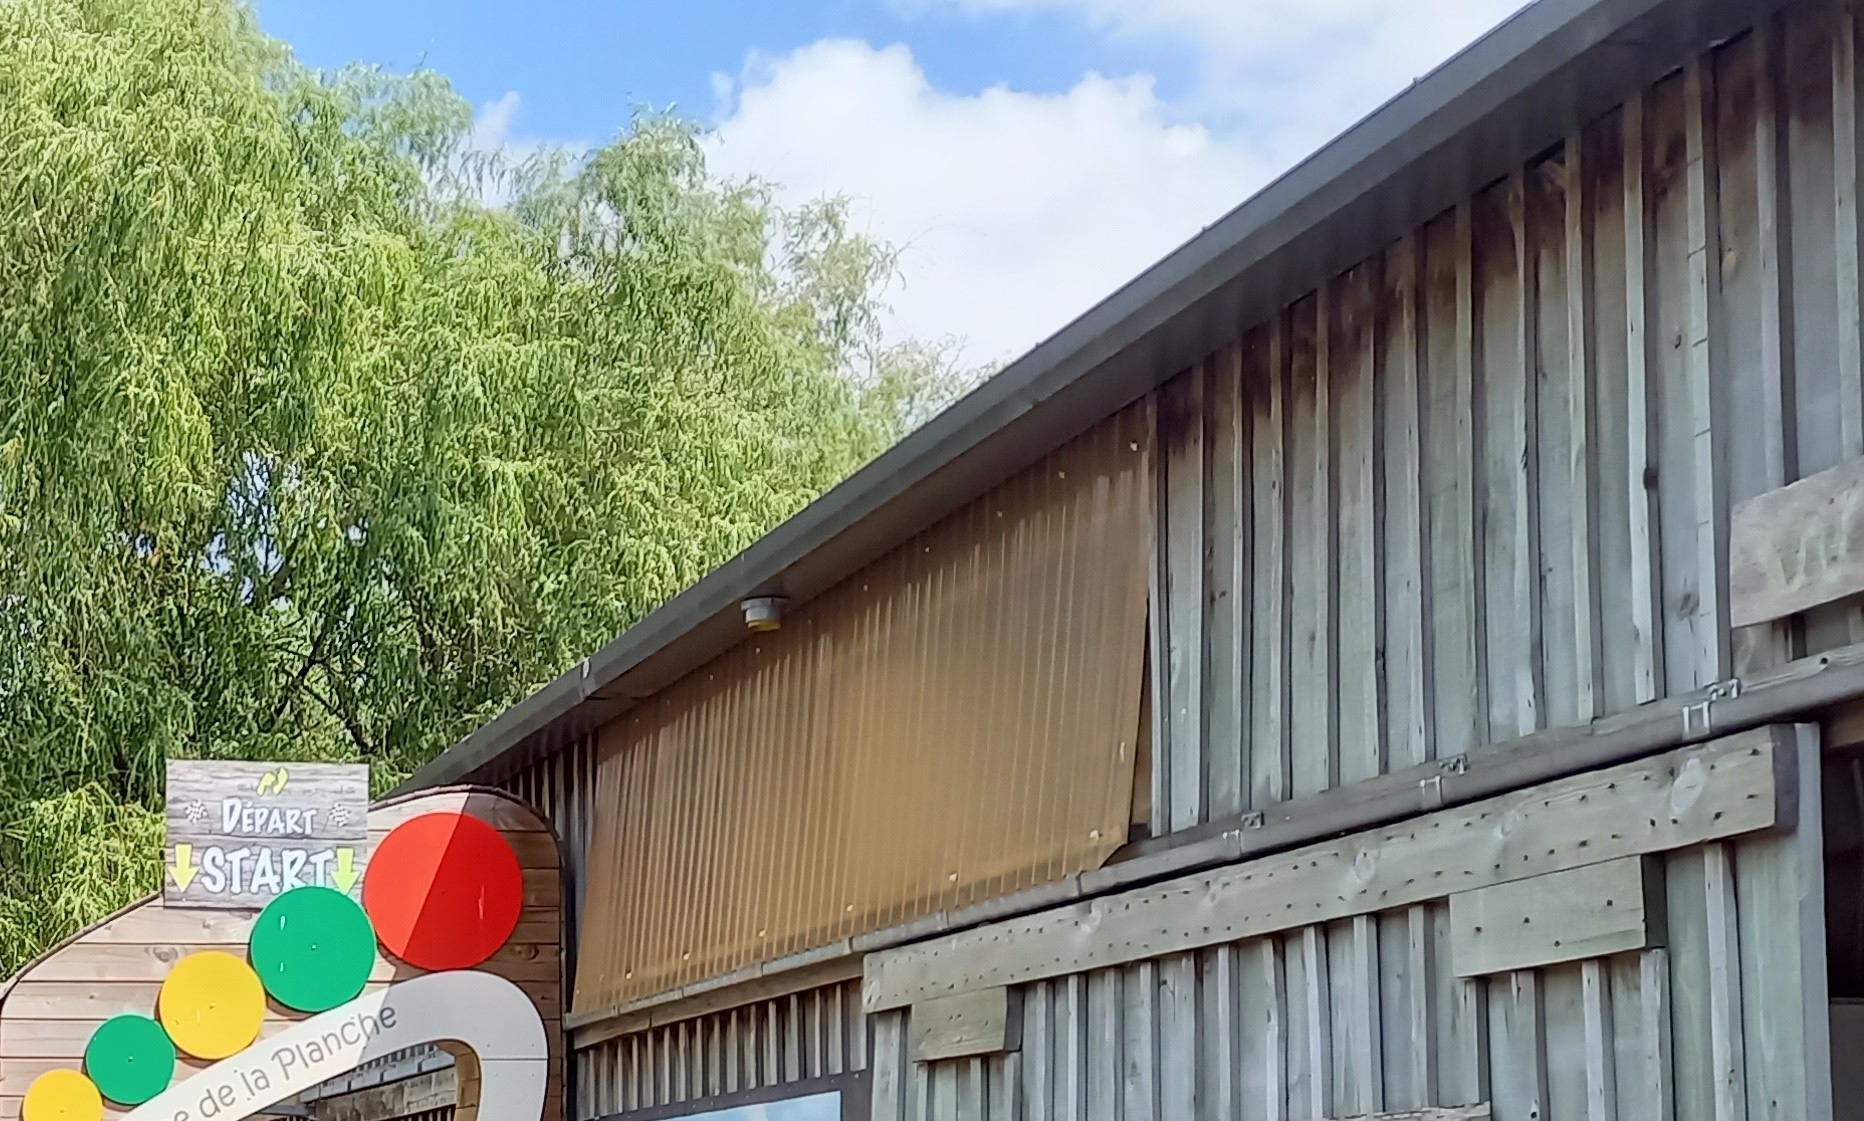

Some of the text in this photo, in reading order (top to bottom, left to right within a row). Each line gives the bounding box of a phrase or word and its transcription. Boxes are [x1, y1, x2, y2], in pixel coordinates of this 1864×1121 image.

[201, 845, 335, 894] START
[199, 1084, 235, 1118] de
[240, 1070, 270, 1098] la
[271, 1005, 397, 1080] Planche
